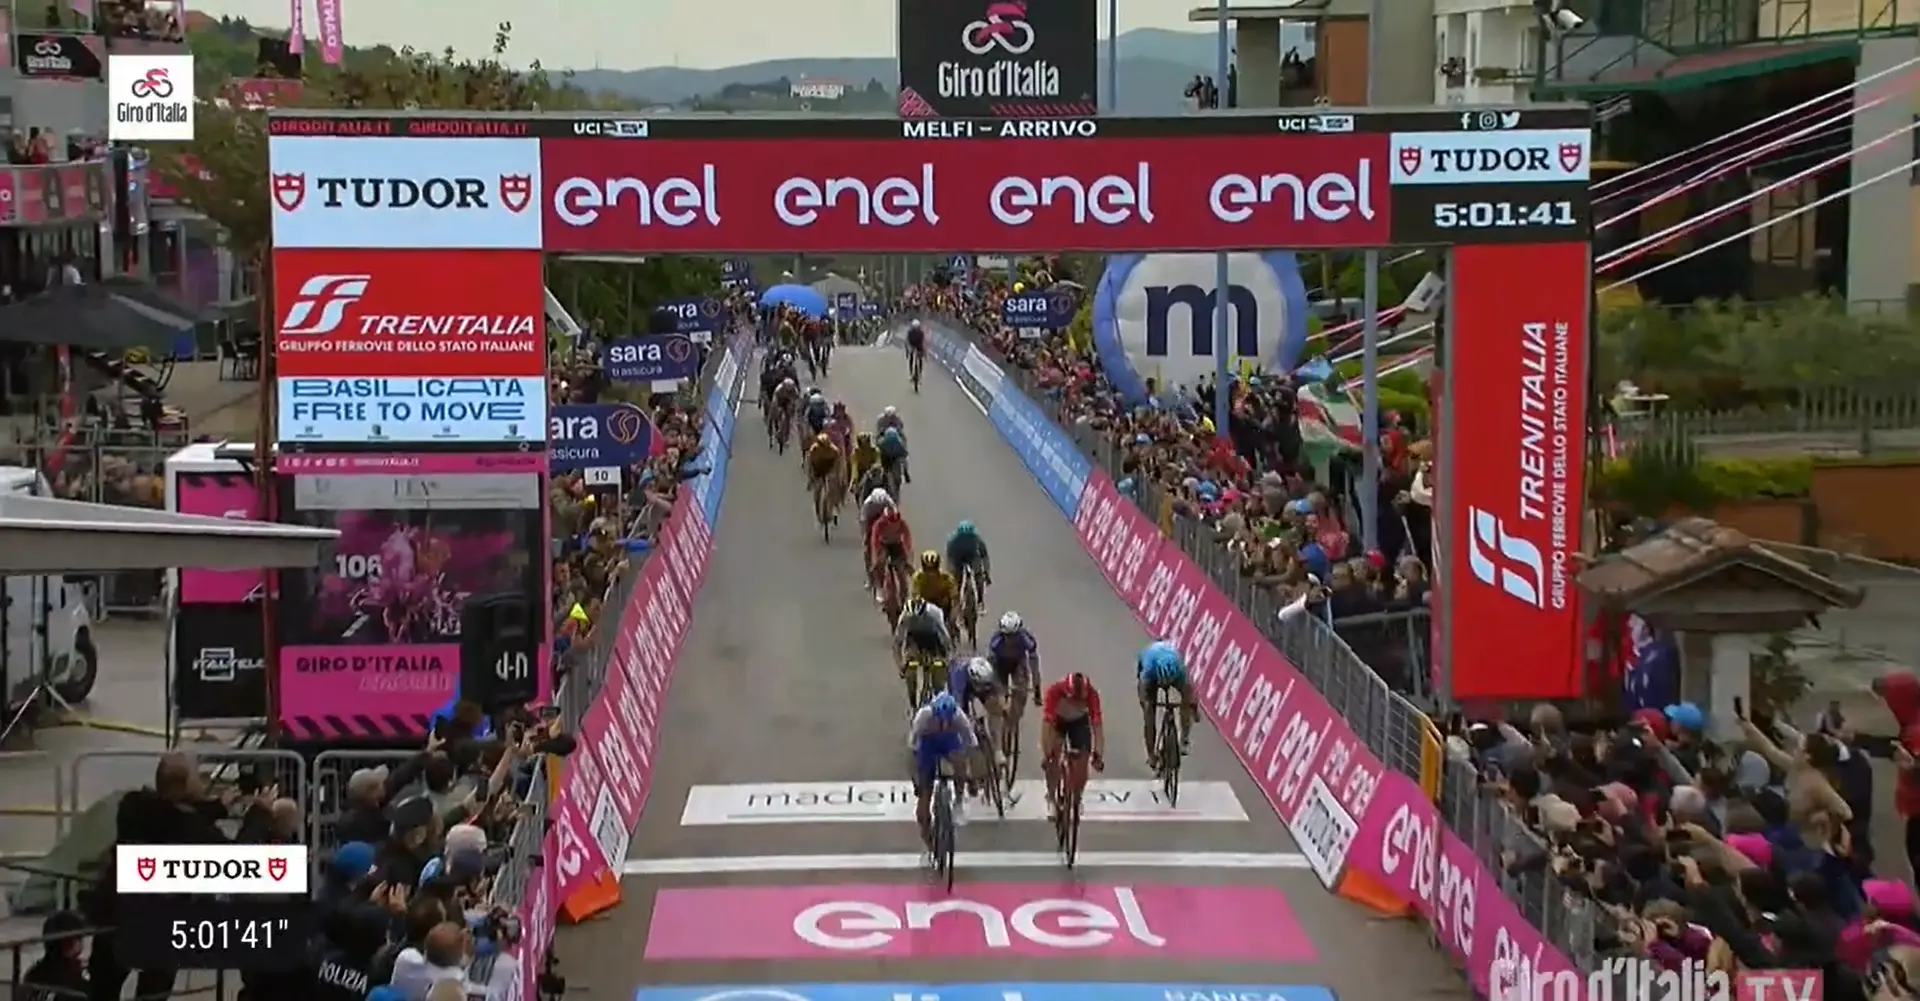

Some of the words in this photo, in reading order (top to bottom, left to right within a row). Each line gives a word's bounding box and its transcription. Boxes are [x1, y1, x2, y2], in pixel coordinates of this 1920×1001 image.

[938, 61, 983, 98] Giro
[988, 60, 1059, 97] d'Italia
[573, 122, 601, 135] UCI
[903, 121, 973, 137] MELFI
[1000, 120, 1096, 137] ARRIVO
[1278, 118, 1306, 131] UCI
[1431, 147, 1550, 173] TUDOR
[317, 178, 489, 209] TUDOR
[554, 163, 721, 226] enel
[774, 163, 940, 226] enel
[990, 161, 1154, 225] enel
[1209, 158, 1375, 222] enel
[1435, 201, 1577, 227] 5:01:41
[1006, 297, 1047, 312] sara
[359, 315, 534, 335] TRENITALIA
[279, 340, 332, 352] GRUPPO
[335, 340, 393, 352] FERROVIE
[397, 340, 436, 352] DELLO
[439, 340, 477, 352] STATO
[480, 340, 535, 352] ITALIANE
[610, 343, 662, 363] sara
[1554, 321, 1569, 383] ITALIANE
[292, 378, 525, 398] BASILICATA
[293, 402, 367, 421] FREE
[377, 402, 411, 421] TO
[421, 402, 526, 421] MOVE
[1520, 321, 1548, 521] TRENITALIA
[1553, 385, 1568, 431] STATO
[550, 414, 599, 440] ara
[550, 447, 600, 460] ssicura
[1552, 435, 1568, 479] DELLO
[594, 470, 609, 482] 10
[1552, 482, 1567, 550] FERROVIE
[1551, 551, 1567, 609] GRUPPO
[296, 656, 348, 674] GIRO
[352, 655, 443, 673] D'ITALIA
[793, 887, 1166, 949] enel
[318, 960, 368, 994] POLIZIA
